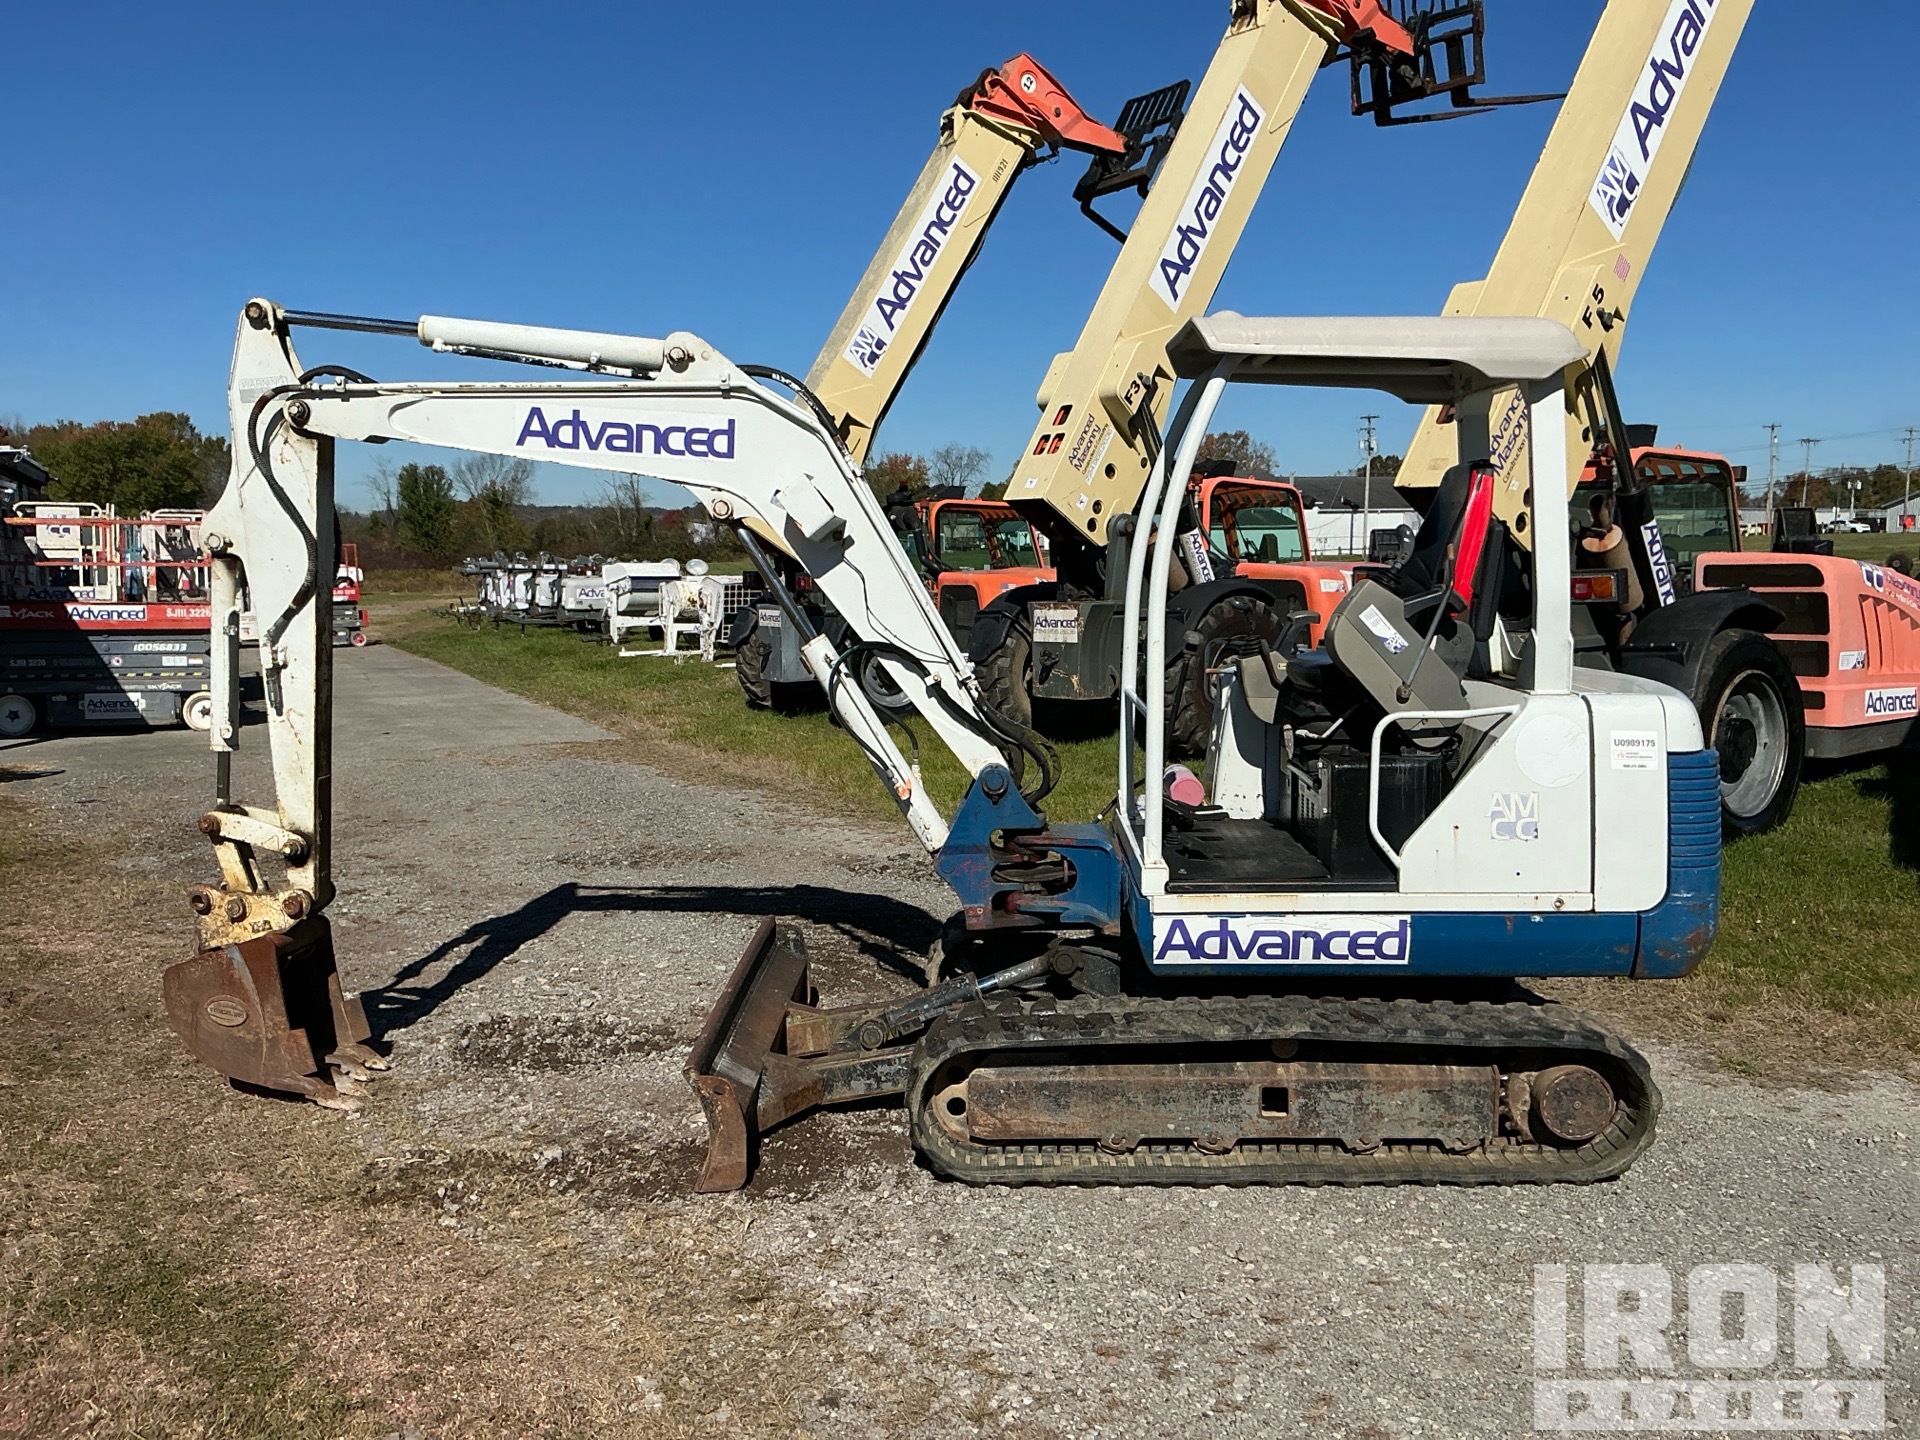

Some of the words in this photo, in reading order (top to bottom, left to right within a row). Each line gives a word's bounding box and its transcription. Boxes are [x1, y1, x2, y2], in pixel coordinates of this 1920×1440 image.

[1023, 76, 1034, 92] 12
[1160, 92, 1261, 303] Advanced
[876, 162, 976, 332] Advanced
[1124, 379, 1141, 406] F3
[516, 406, 736, 460] Advanced
[1068, 413, 1095, 466] Advanced
[1073, 424, 1102, 472] Masonry
[27, 587, 96, 600] Advanced
[68, 606, 147, 620] Advanced
[1034, 616, 1077, 629] Advanced
[1865, 688, 1918, 714] Advanced
[1613, 738, 1656, 748] U0989175
[1155, 918, 1408, 961] Advanced
